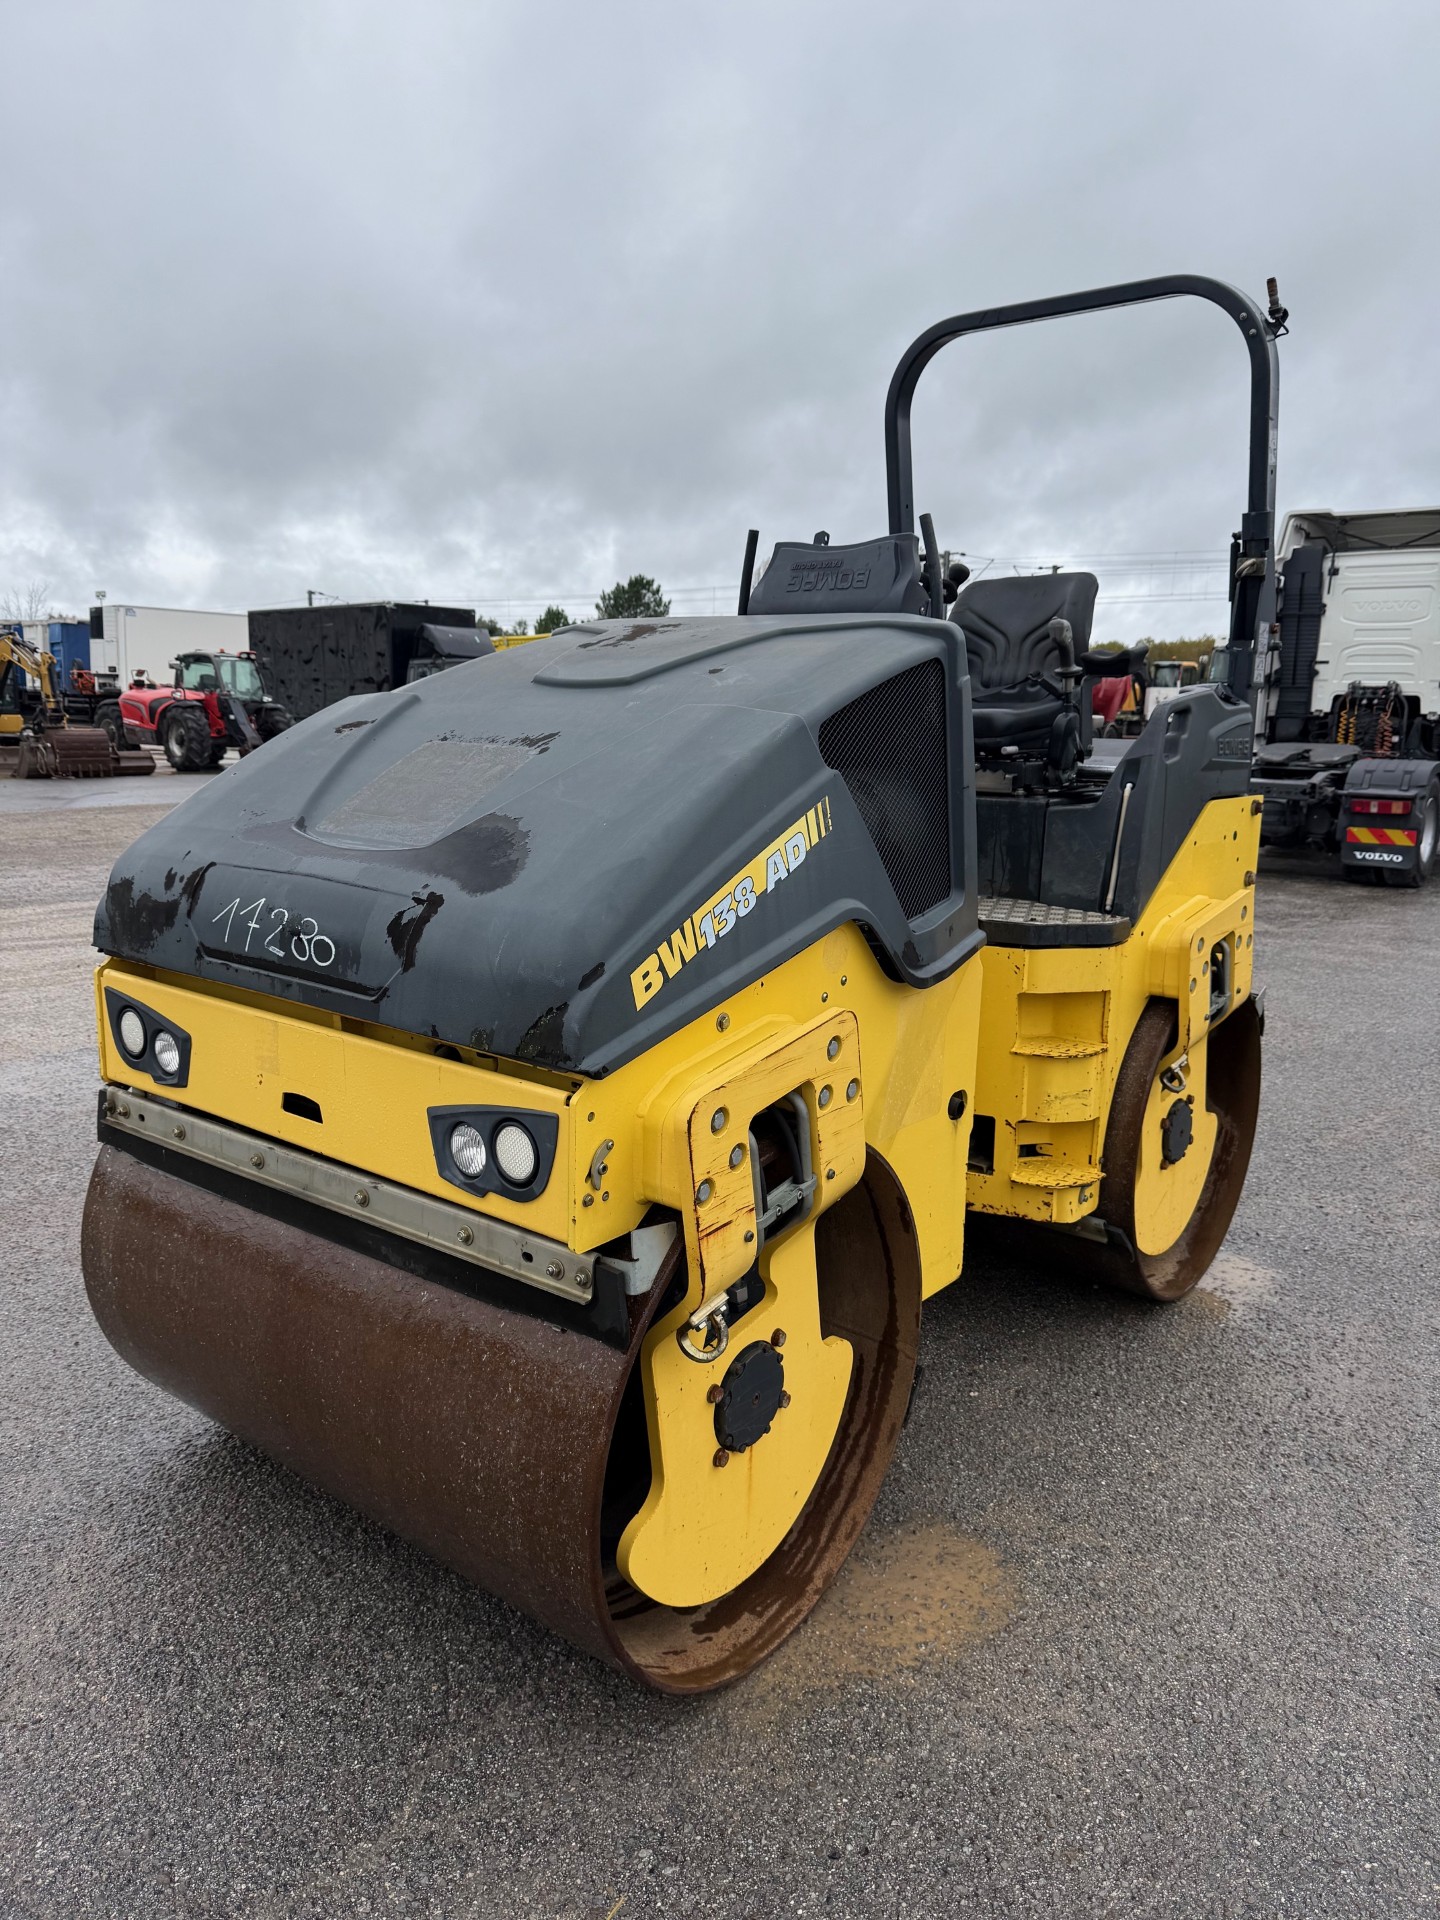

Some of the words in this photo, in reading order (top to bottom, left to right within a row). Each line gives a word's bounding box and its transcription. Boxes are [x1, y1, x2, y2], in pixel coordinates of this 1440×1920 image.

[786, 568, 872, 593] BOMAG
[1351, 600, 1421, 613] VOLVO
[766, 831, 807, 894] AD
[1352, 850, 1404, 863] VOLVO
